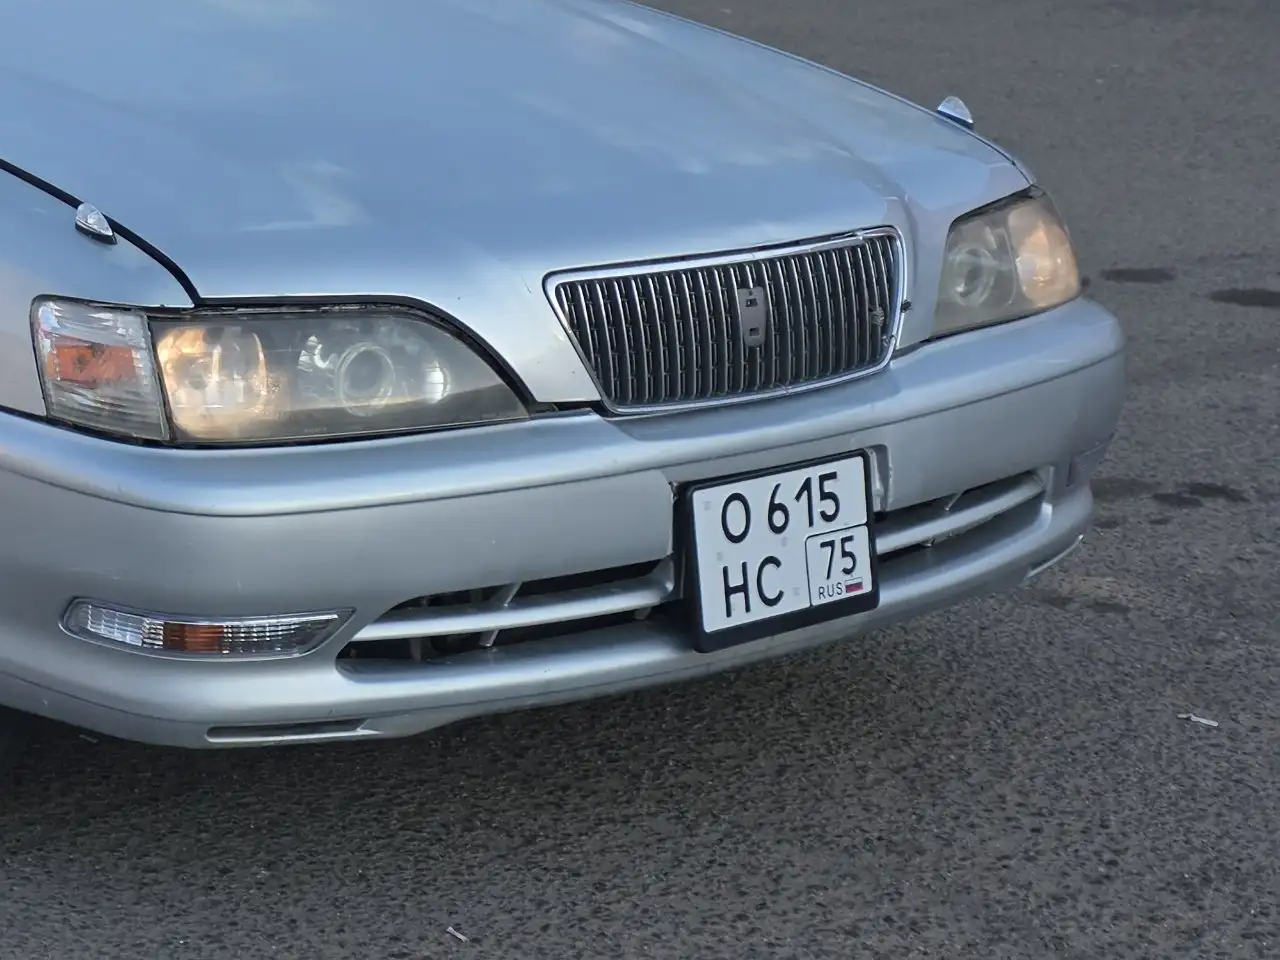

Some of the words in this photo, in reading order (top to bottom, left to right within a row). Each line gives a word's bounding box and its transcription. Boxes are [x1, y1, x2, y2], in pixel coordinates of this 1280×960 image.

[767, 471, 841, 535] 615
[820, 535, 857, 580] 75
[818, 582, 844, 600] RUS
